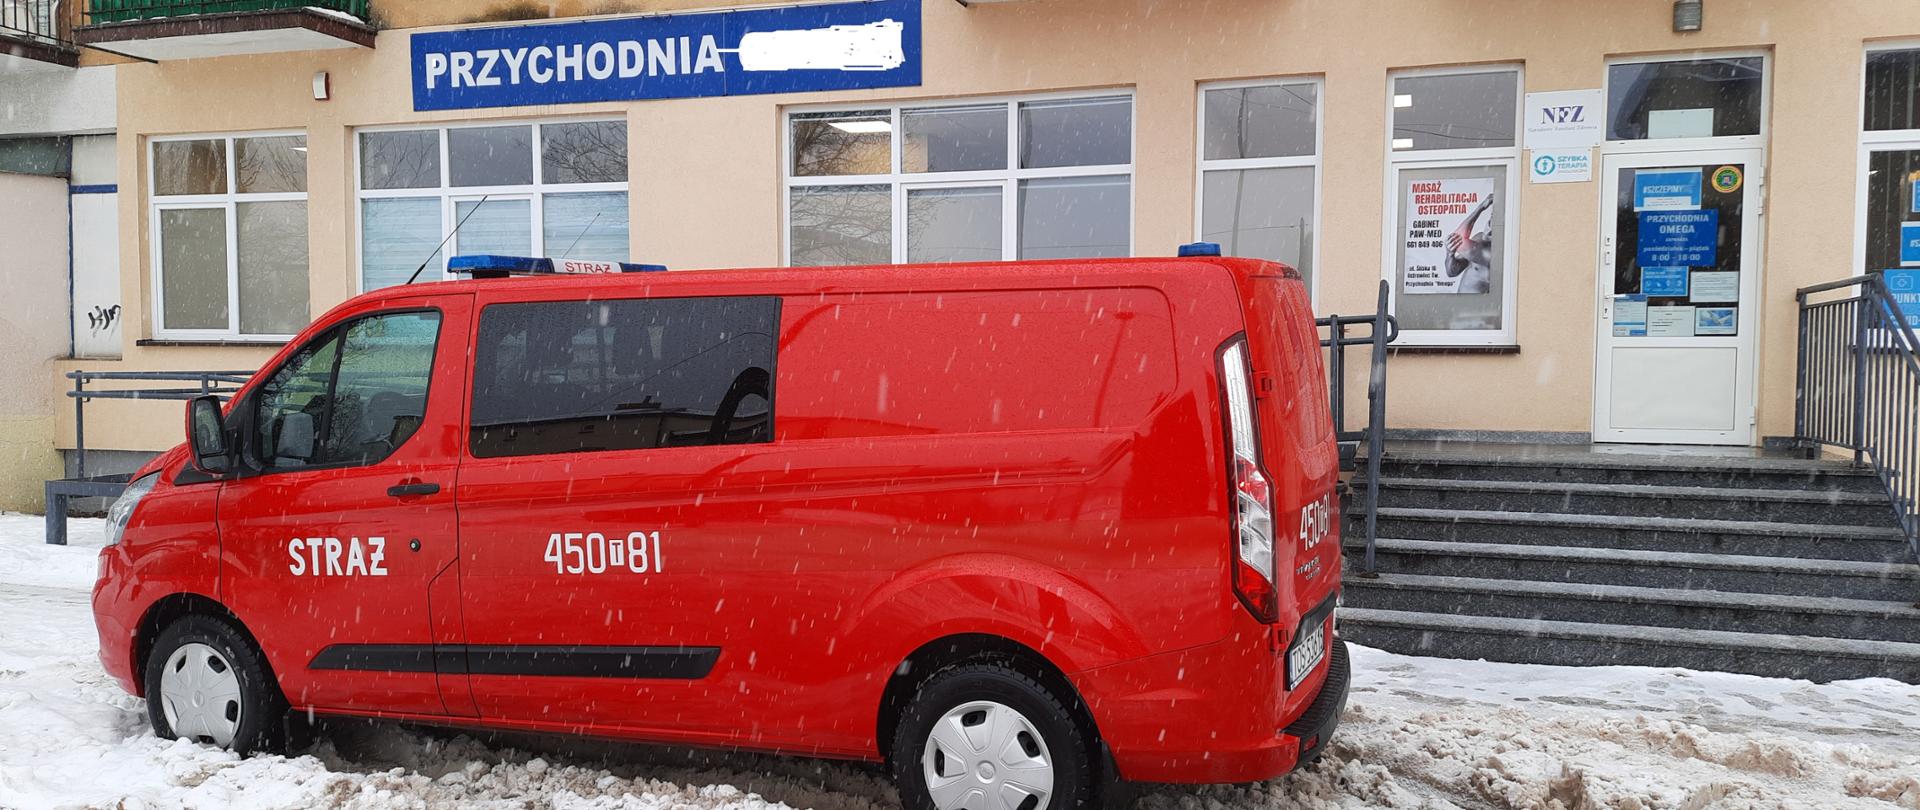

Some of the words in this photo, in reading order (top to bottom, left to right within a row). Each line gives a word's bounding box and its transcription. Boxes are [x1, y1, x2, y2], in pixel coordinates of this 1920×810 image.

[425, 34, 725, 89] PRZYCHODNIA
[1541, 105, 1585, 124] NFZ
[1412, 181, 1442, 193] MASAŻ
[1415, 193, 1478, 204] REHABILITACJA
[1418, 204, 1467, 215] OSTEOPATIA
[1647, 214, 1709, 223] PRZYCHODNIA
[1413, 220, 1440, 229] GABINET
[1659, 225, 1695, 233] OMEGA
[1409, 230, 1442, 238] PAW-MED
